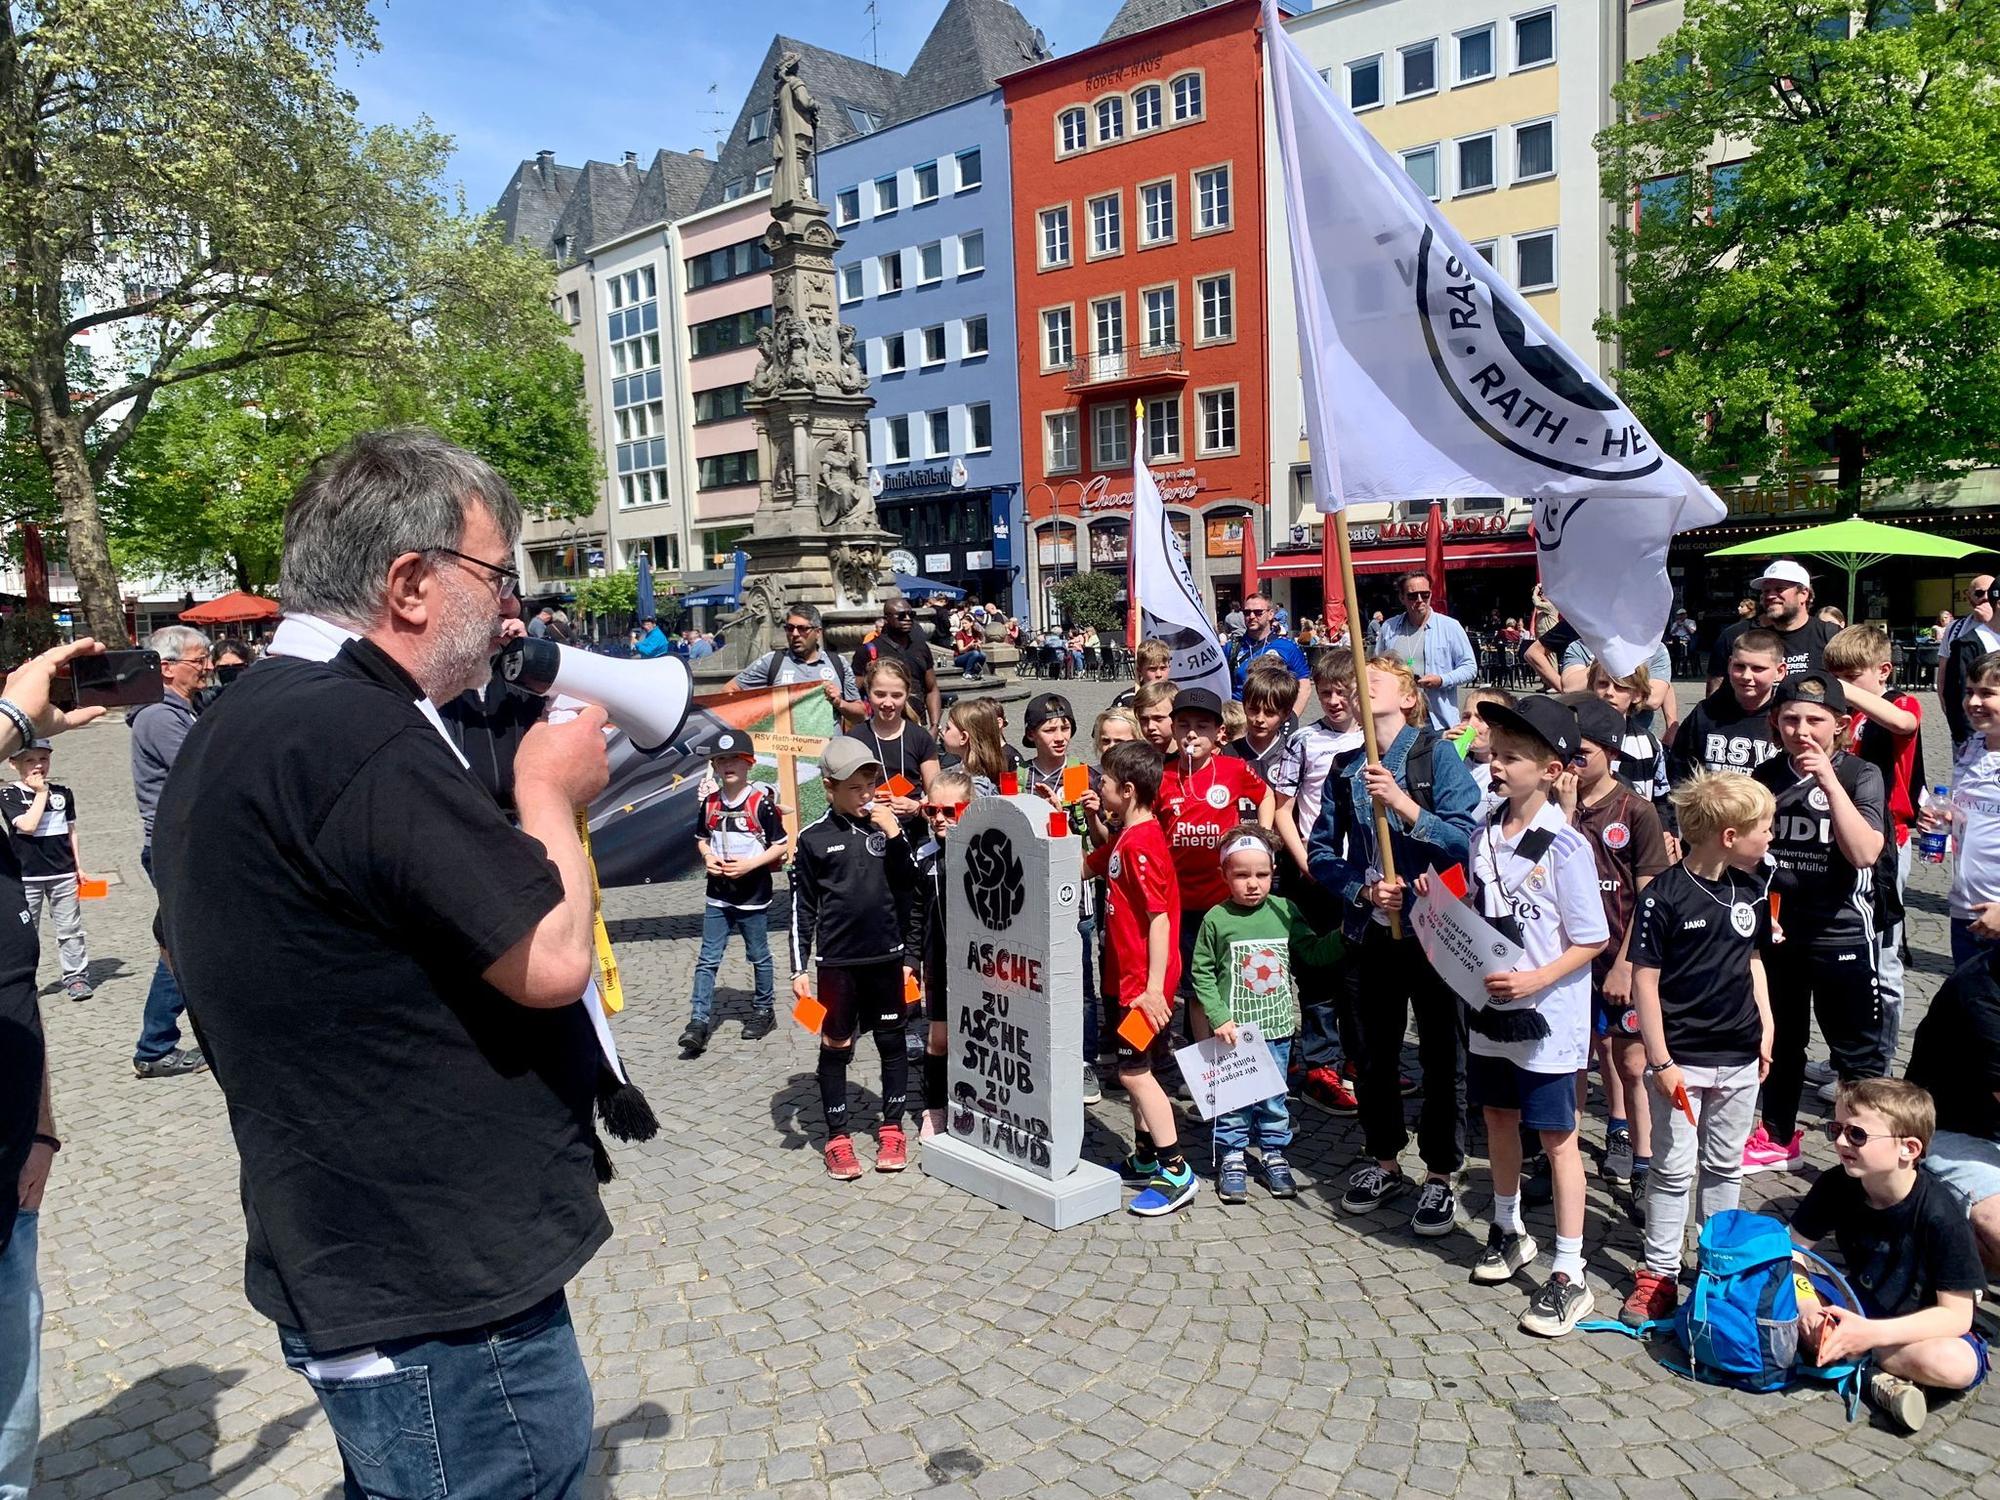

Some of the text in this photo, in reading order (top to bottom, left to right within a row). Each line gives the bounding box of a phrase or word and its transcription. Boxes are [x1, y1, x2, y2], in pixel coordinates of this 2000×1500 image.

[1469, 362, 1569, 445] RATH
[1453, 513, 1507, 535] POLO
[1786, 662, 1809, 670] EREIN.
[754, 733, 823, 745] RSV Rath-Heumar
[771, 744, 789, 752] 1920
[1704, 733, 1783, 768] RSV
[1176, 821, 1220, 836] Rhein
[1797, 861, 1829, 873] Müller
[1683, 919, 1707, 930] JAKO
[1444, 927, 1456, 940] die
[1435, 929, 1460, 957] zeigen
[1456, 940, 1484, 968] Politik
[967, 941, 1044, 993] ASCHE
[1460, 957, 1475, 973] Wir
[982, 990, 1010, 1018] ZU
[959, 1005, 1033, 1064] ASCHE
[962, 1040, 1034, 1094] STAUB
[1220, 1064, 1231, 1073] die
[1230, 1056, 1256, 1070] Politik
[1244, 1065, 1259, 1075] Wir
[1220, 1070, 1244, 1084] zeigen
[985, 1079, 1011, 1106] ZU
